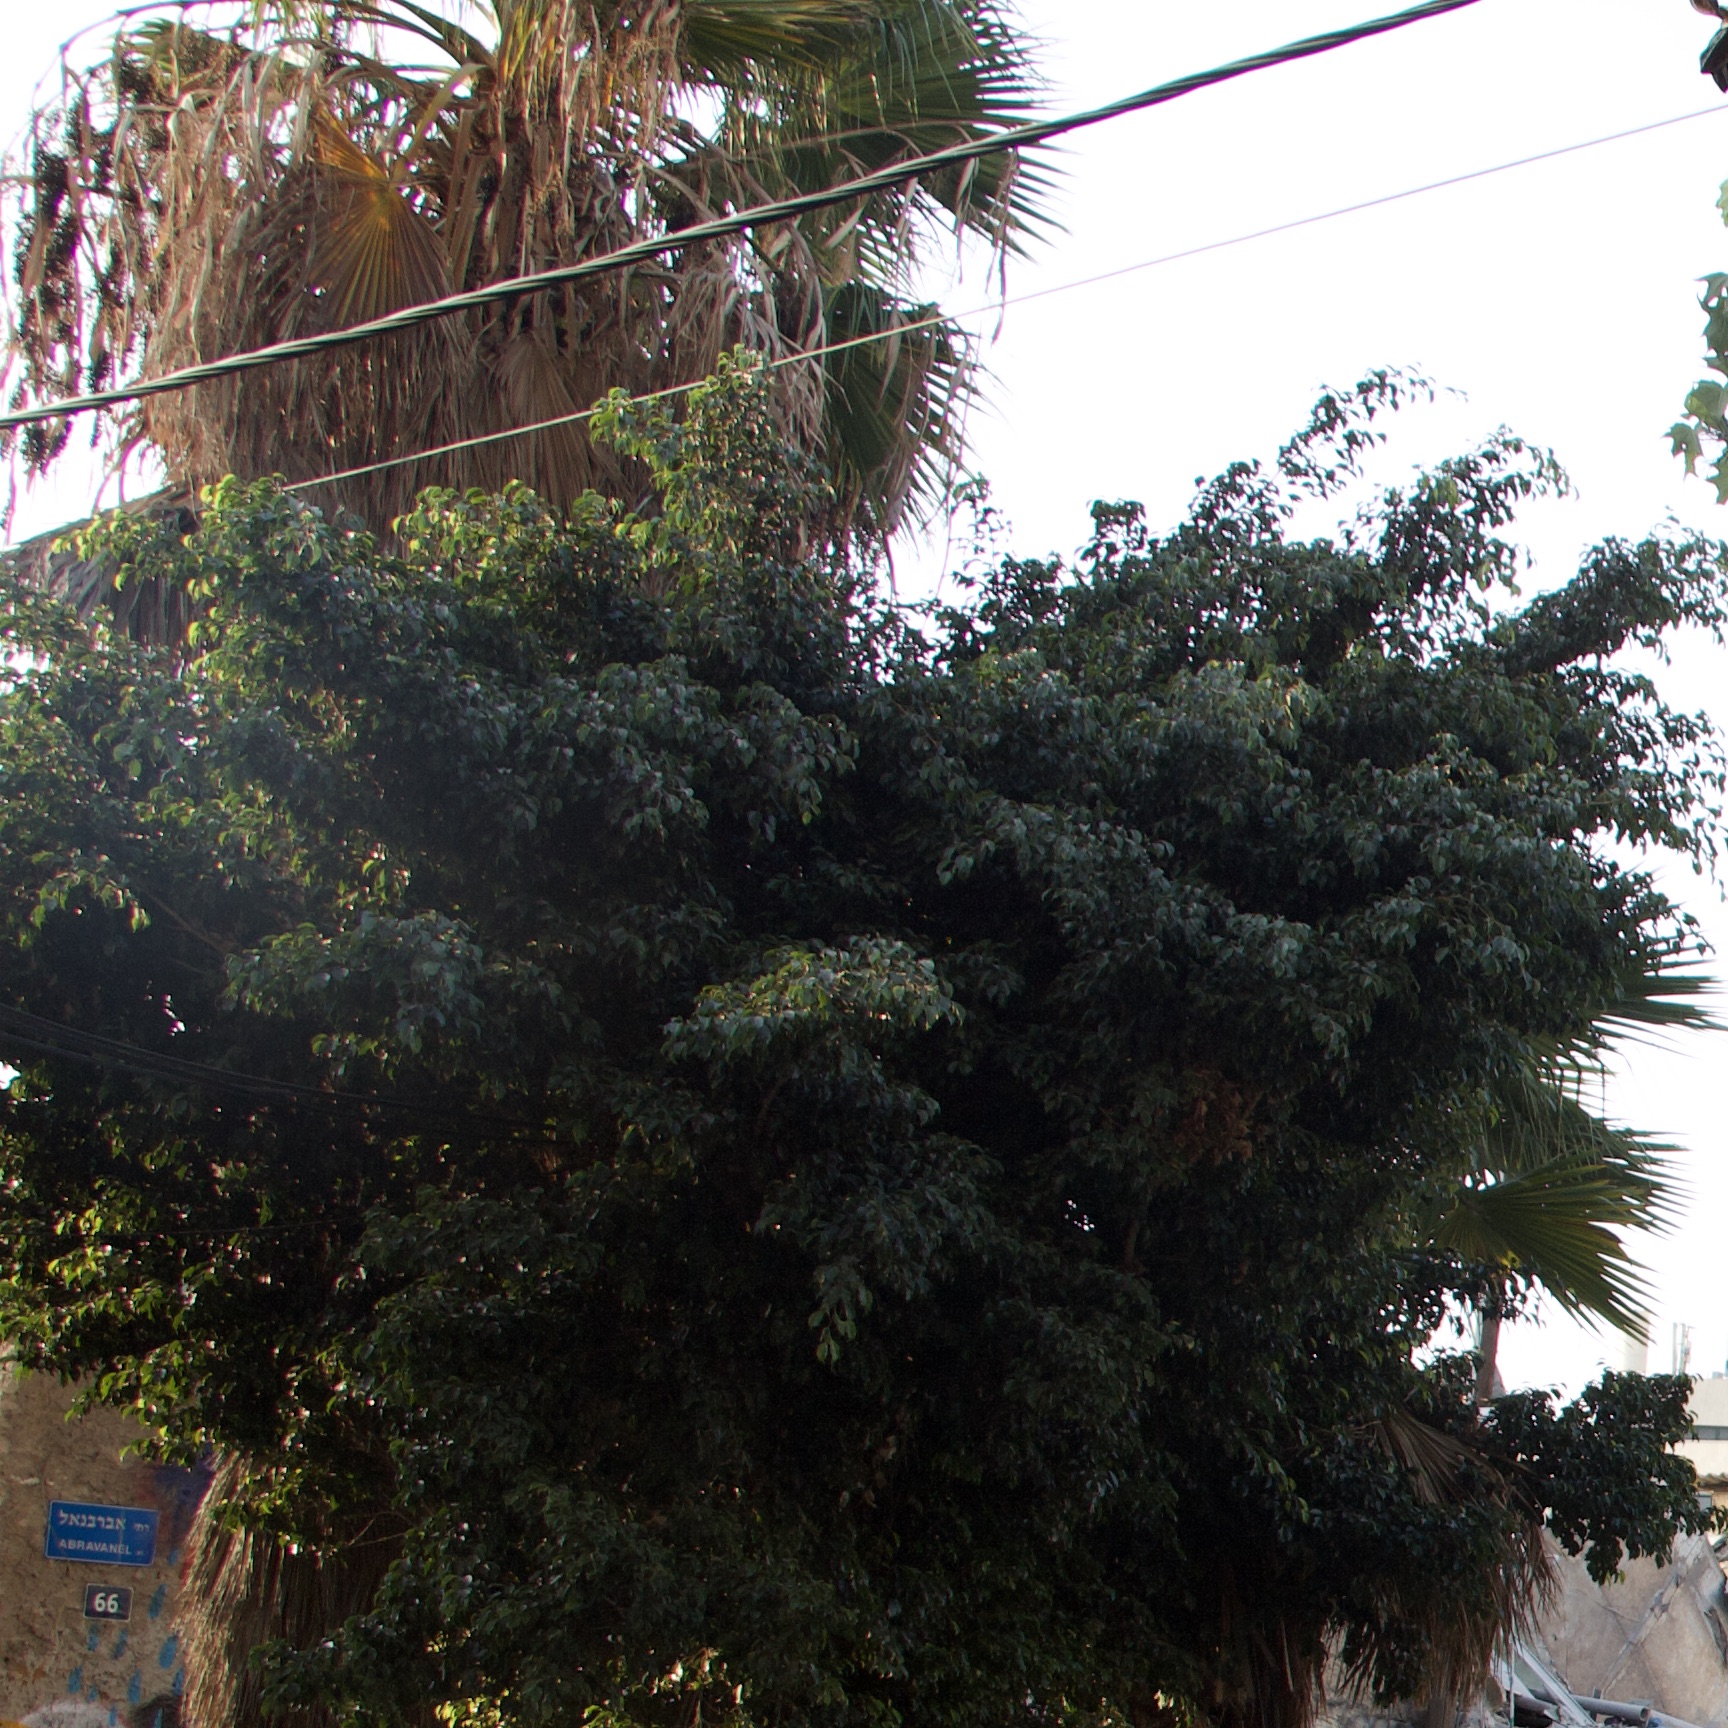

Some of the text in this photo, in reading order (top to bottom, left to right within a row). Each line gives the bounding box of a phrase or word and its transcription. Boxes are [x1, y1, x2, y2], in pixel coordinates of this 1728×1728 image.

[60, 1509, 128, 1531] אברבנאל
[59, 1538, 133, 1556] ABRAVANEL
[94, 1592, 120, 1614] 66
